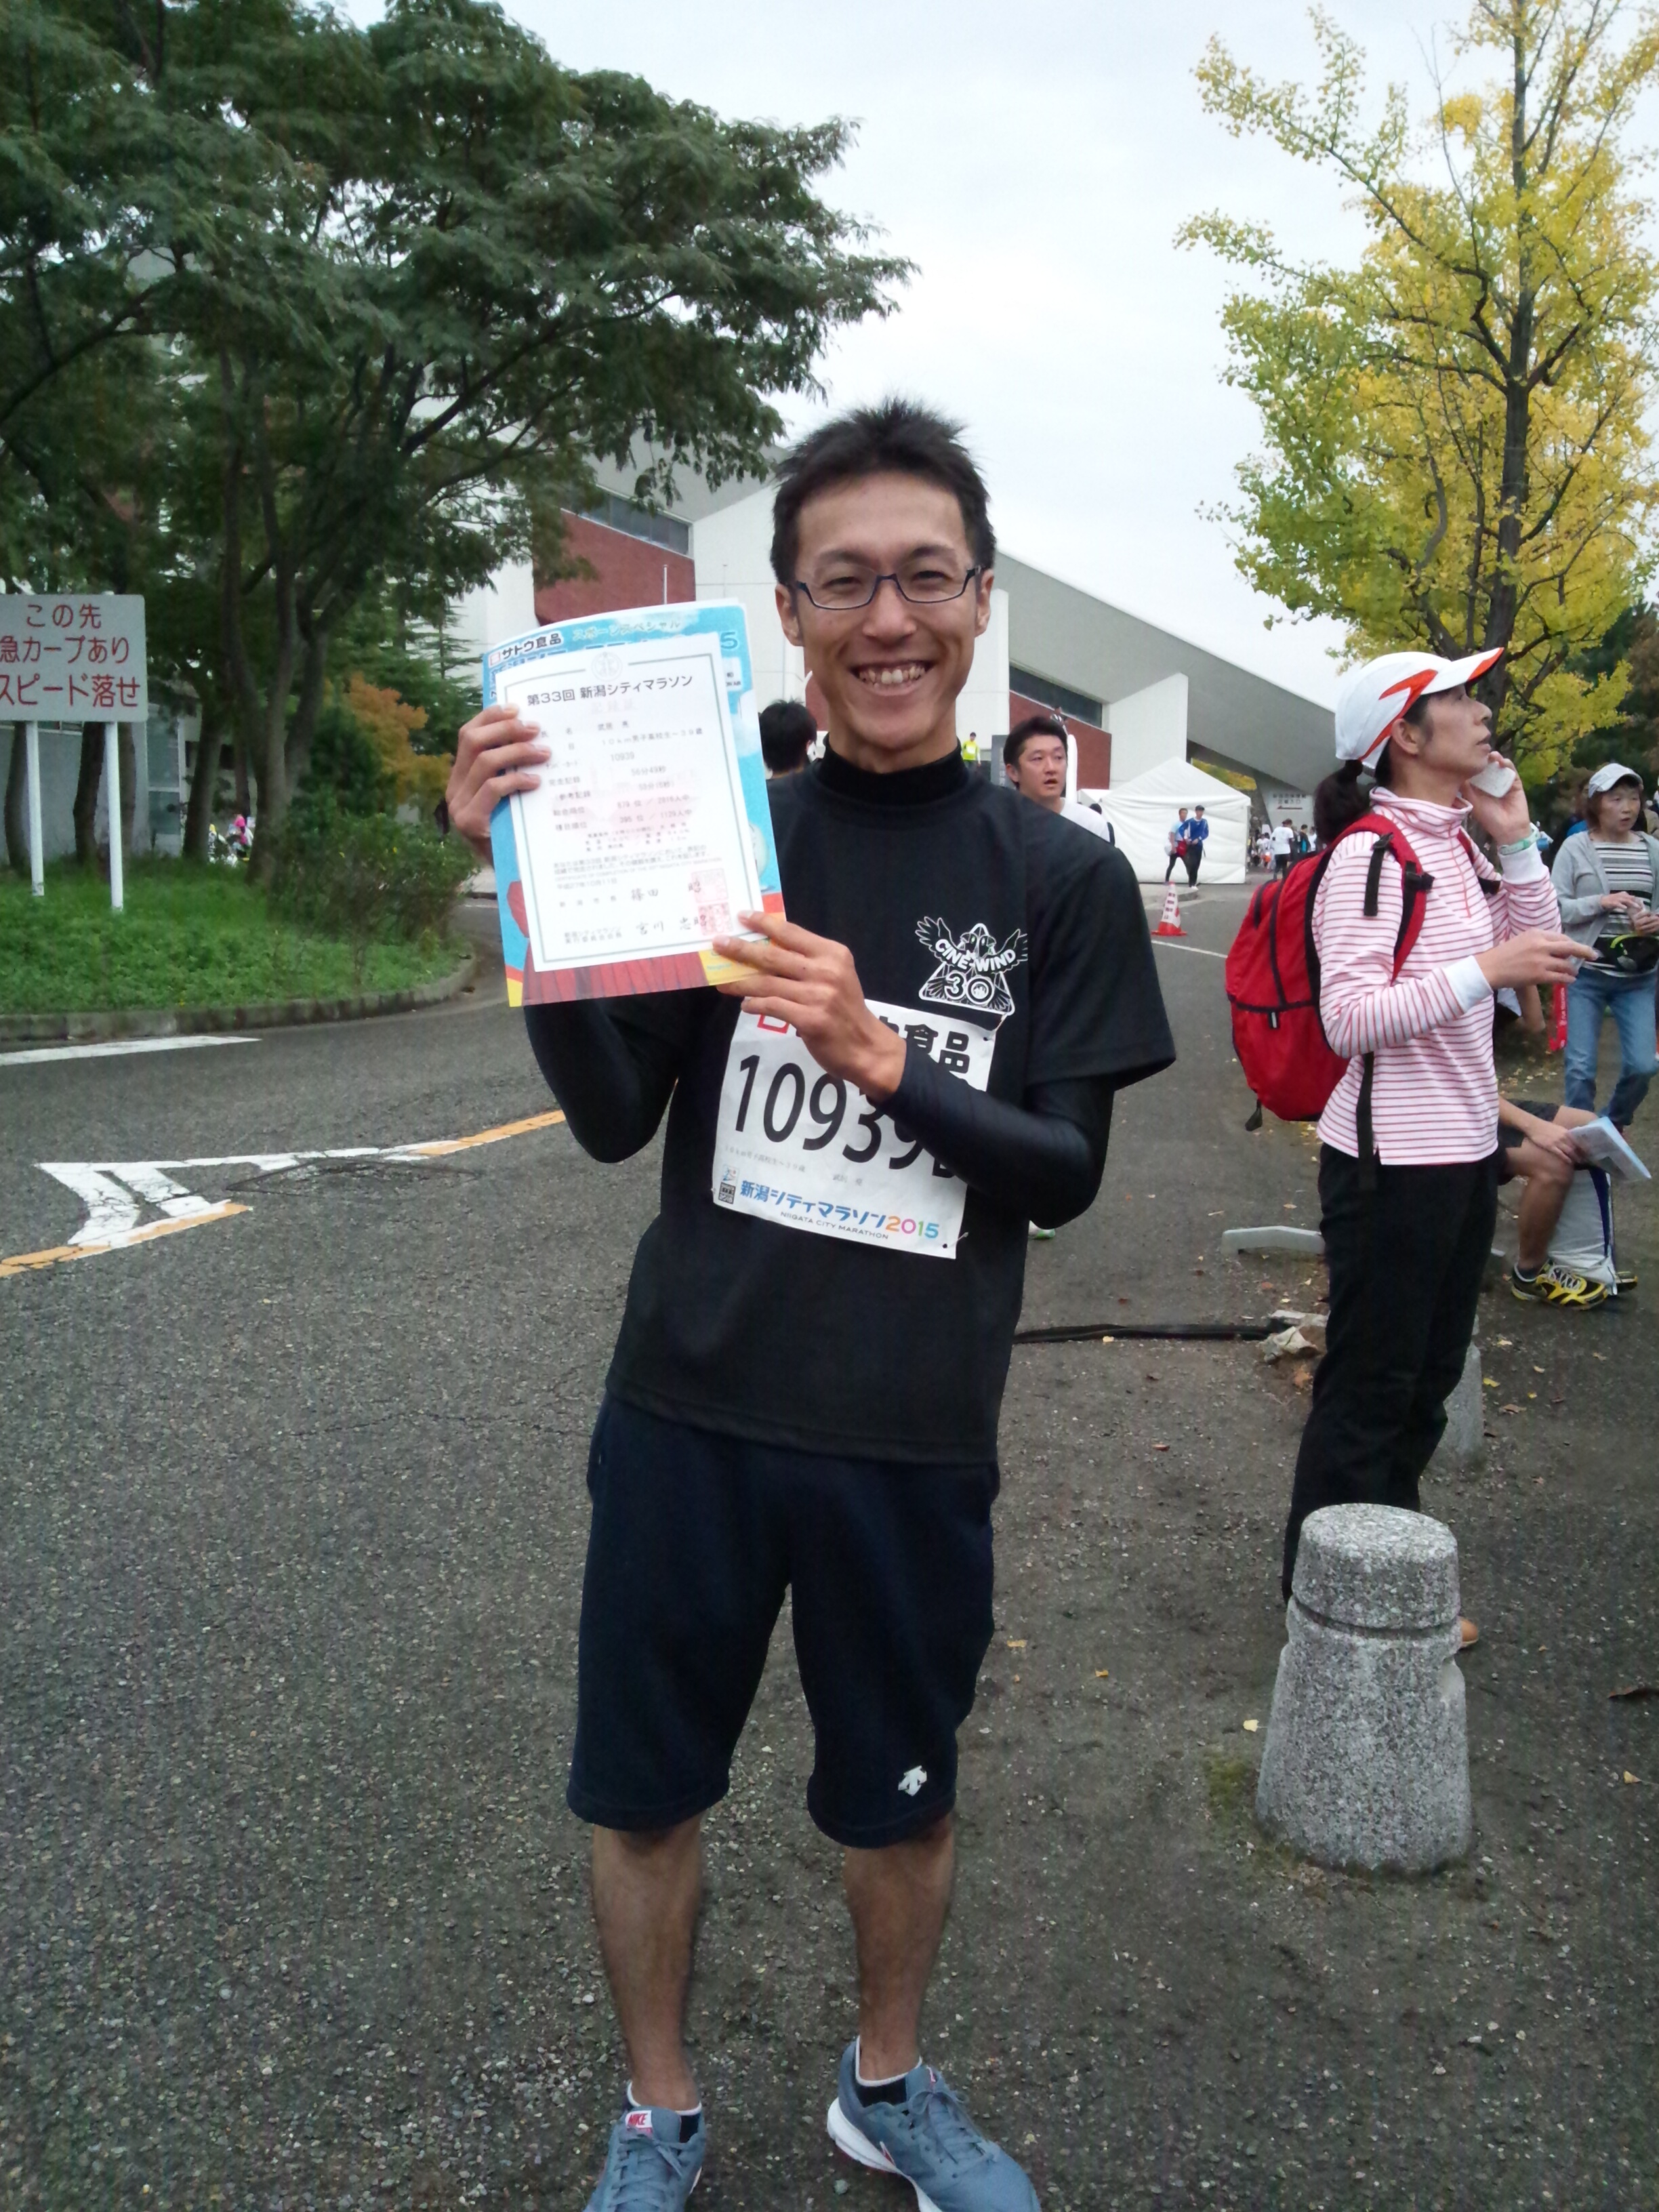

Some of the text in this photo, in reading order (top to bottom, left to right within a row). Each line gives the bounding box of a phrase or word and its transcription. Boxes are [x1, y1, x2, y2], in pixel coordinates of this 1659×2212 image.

[26, 604, 102, 629] この先
[0, 635, 129, 664] 急カーブあり
[502, 633, 562, 659] サトウ食品
[0, 674, 140, 708] スピード落せ
[527, 676, 693, 706] 第33回 新潟シティマラソン
[935, 939, 1016, 972] CINE WIND
[781, 1211, 889, 1240] NIIGATA CITY MARATHON
